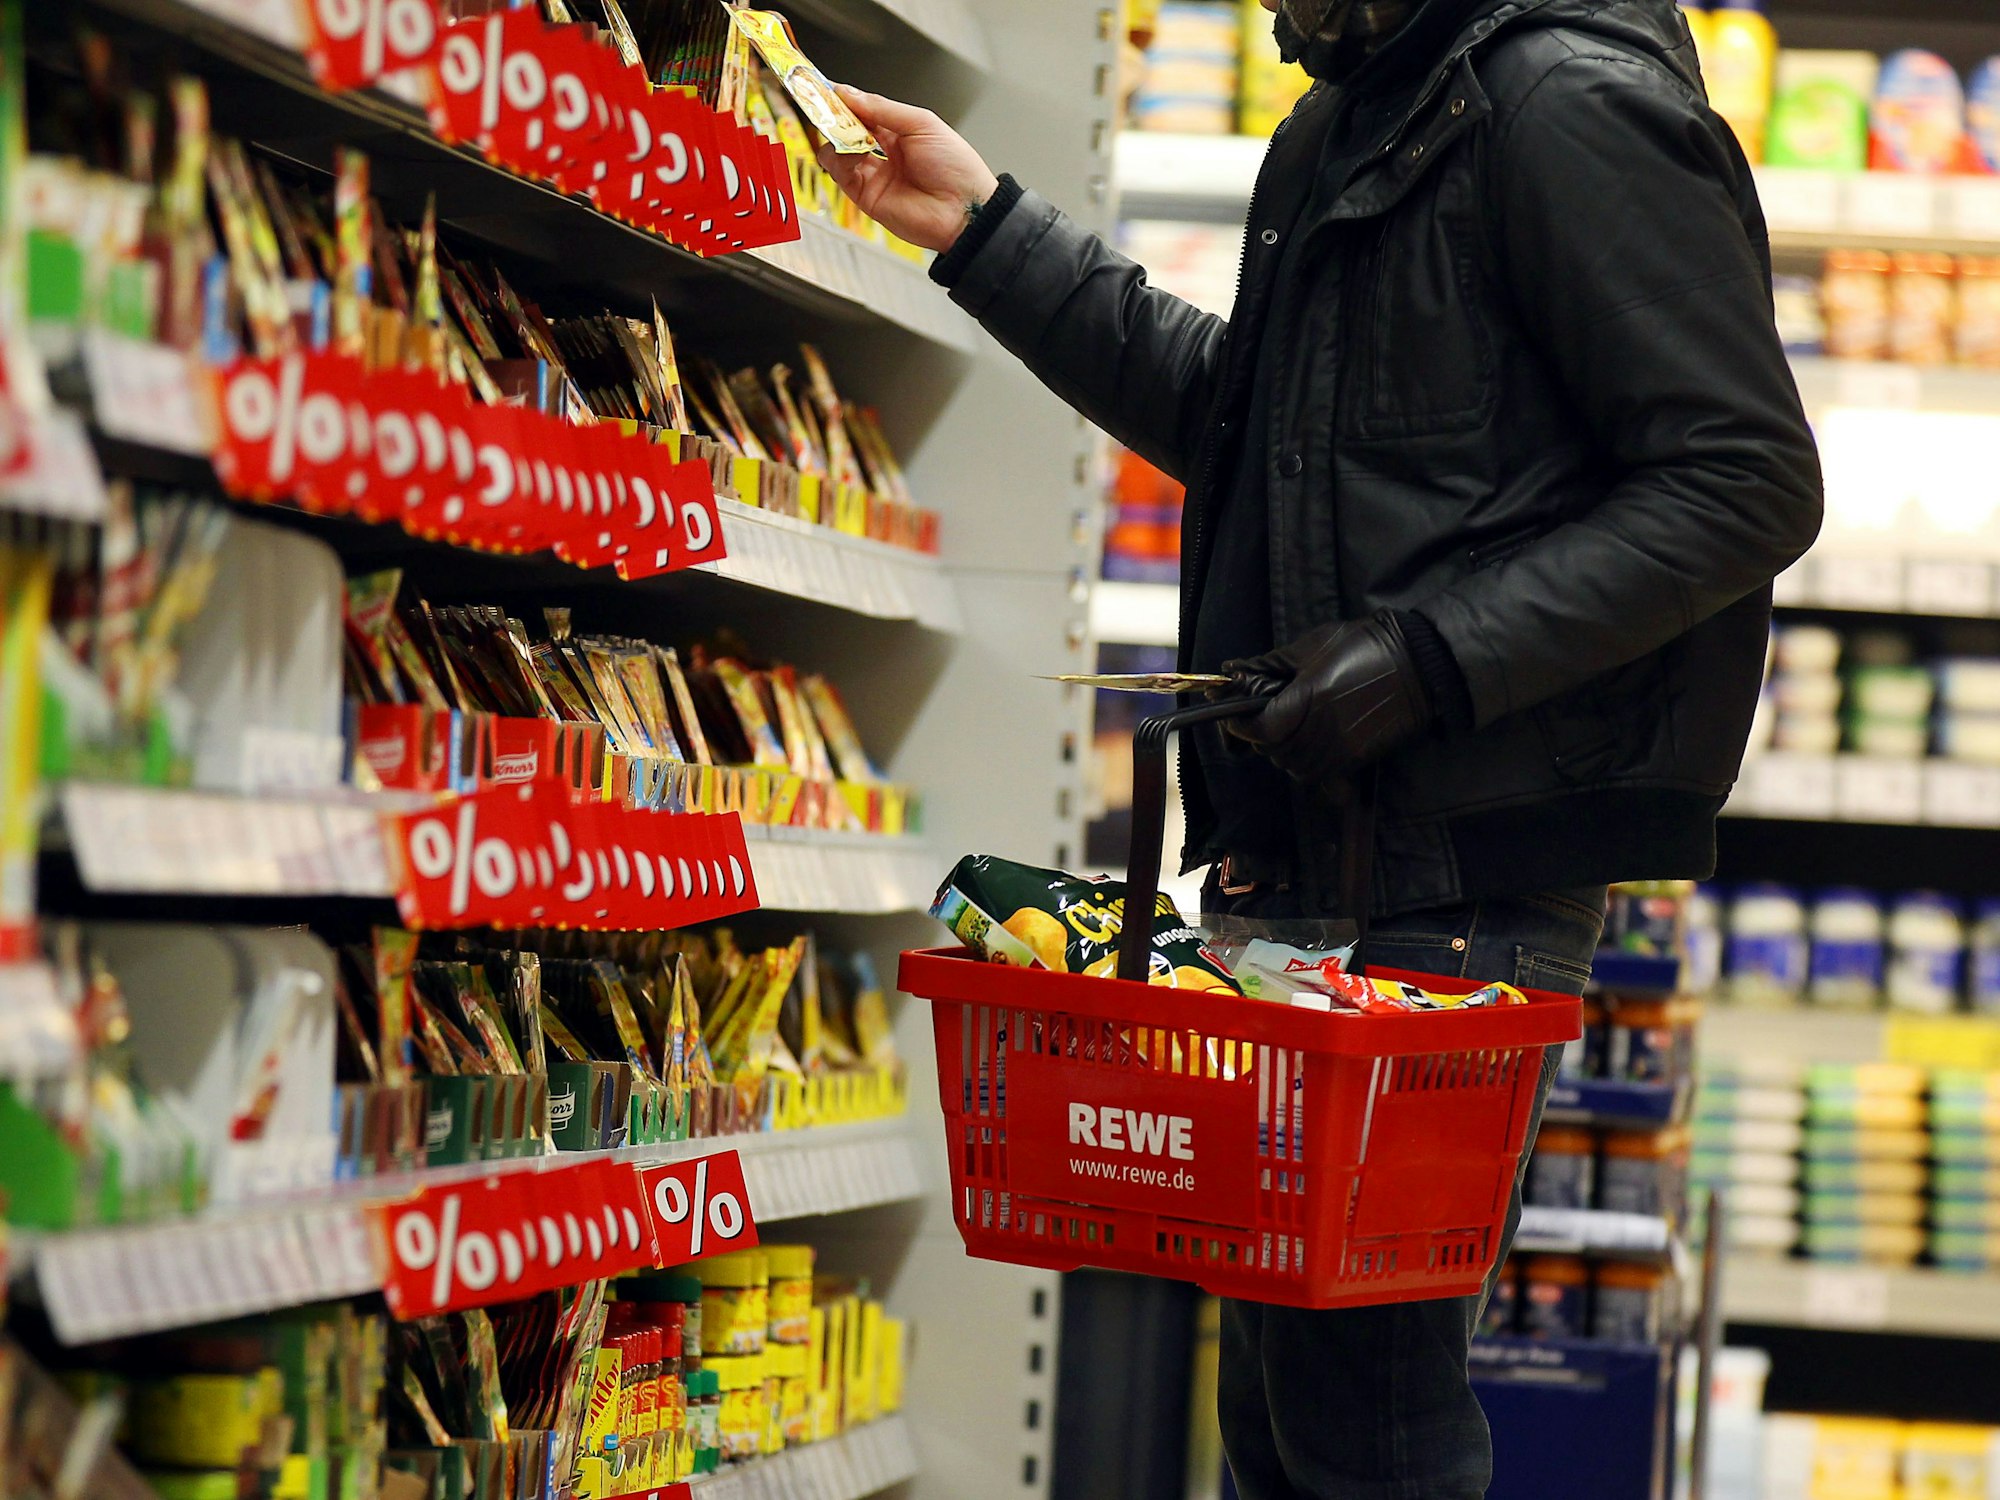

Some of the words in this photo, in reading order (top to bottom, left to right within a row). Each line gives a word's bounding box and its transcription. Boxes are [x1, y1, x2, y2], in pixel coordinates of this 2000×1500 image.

[440, 14, 547, 131] %
[227, 351, 346, 484] %
[410, 801, 518, 916] %
[1069, 1102, 1195, 1160] REWE
[1069, 1158, 1195, 1191] www.rewe.de
[395, 1193, 498, 1306] %
[655, 1160, 744, 1256] %
